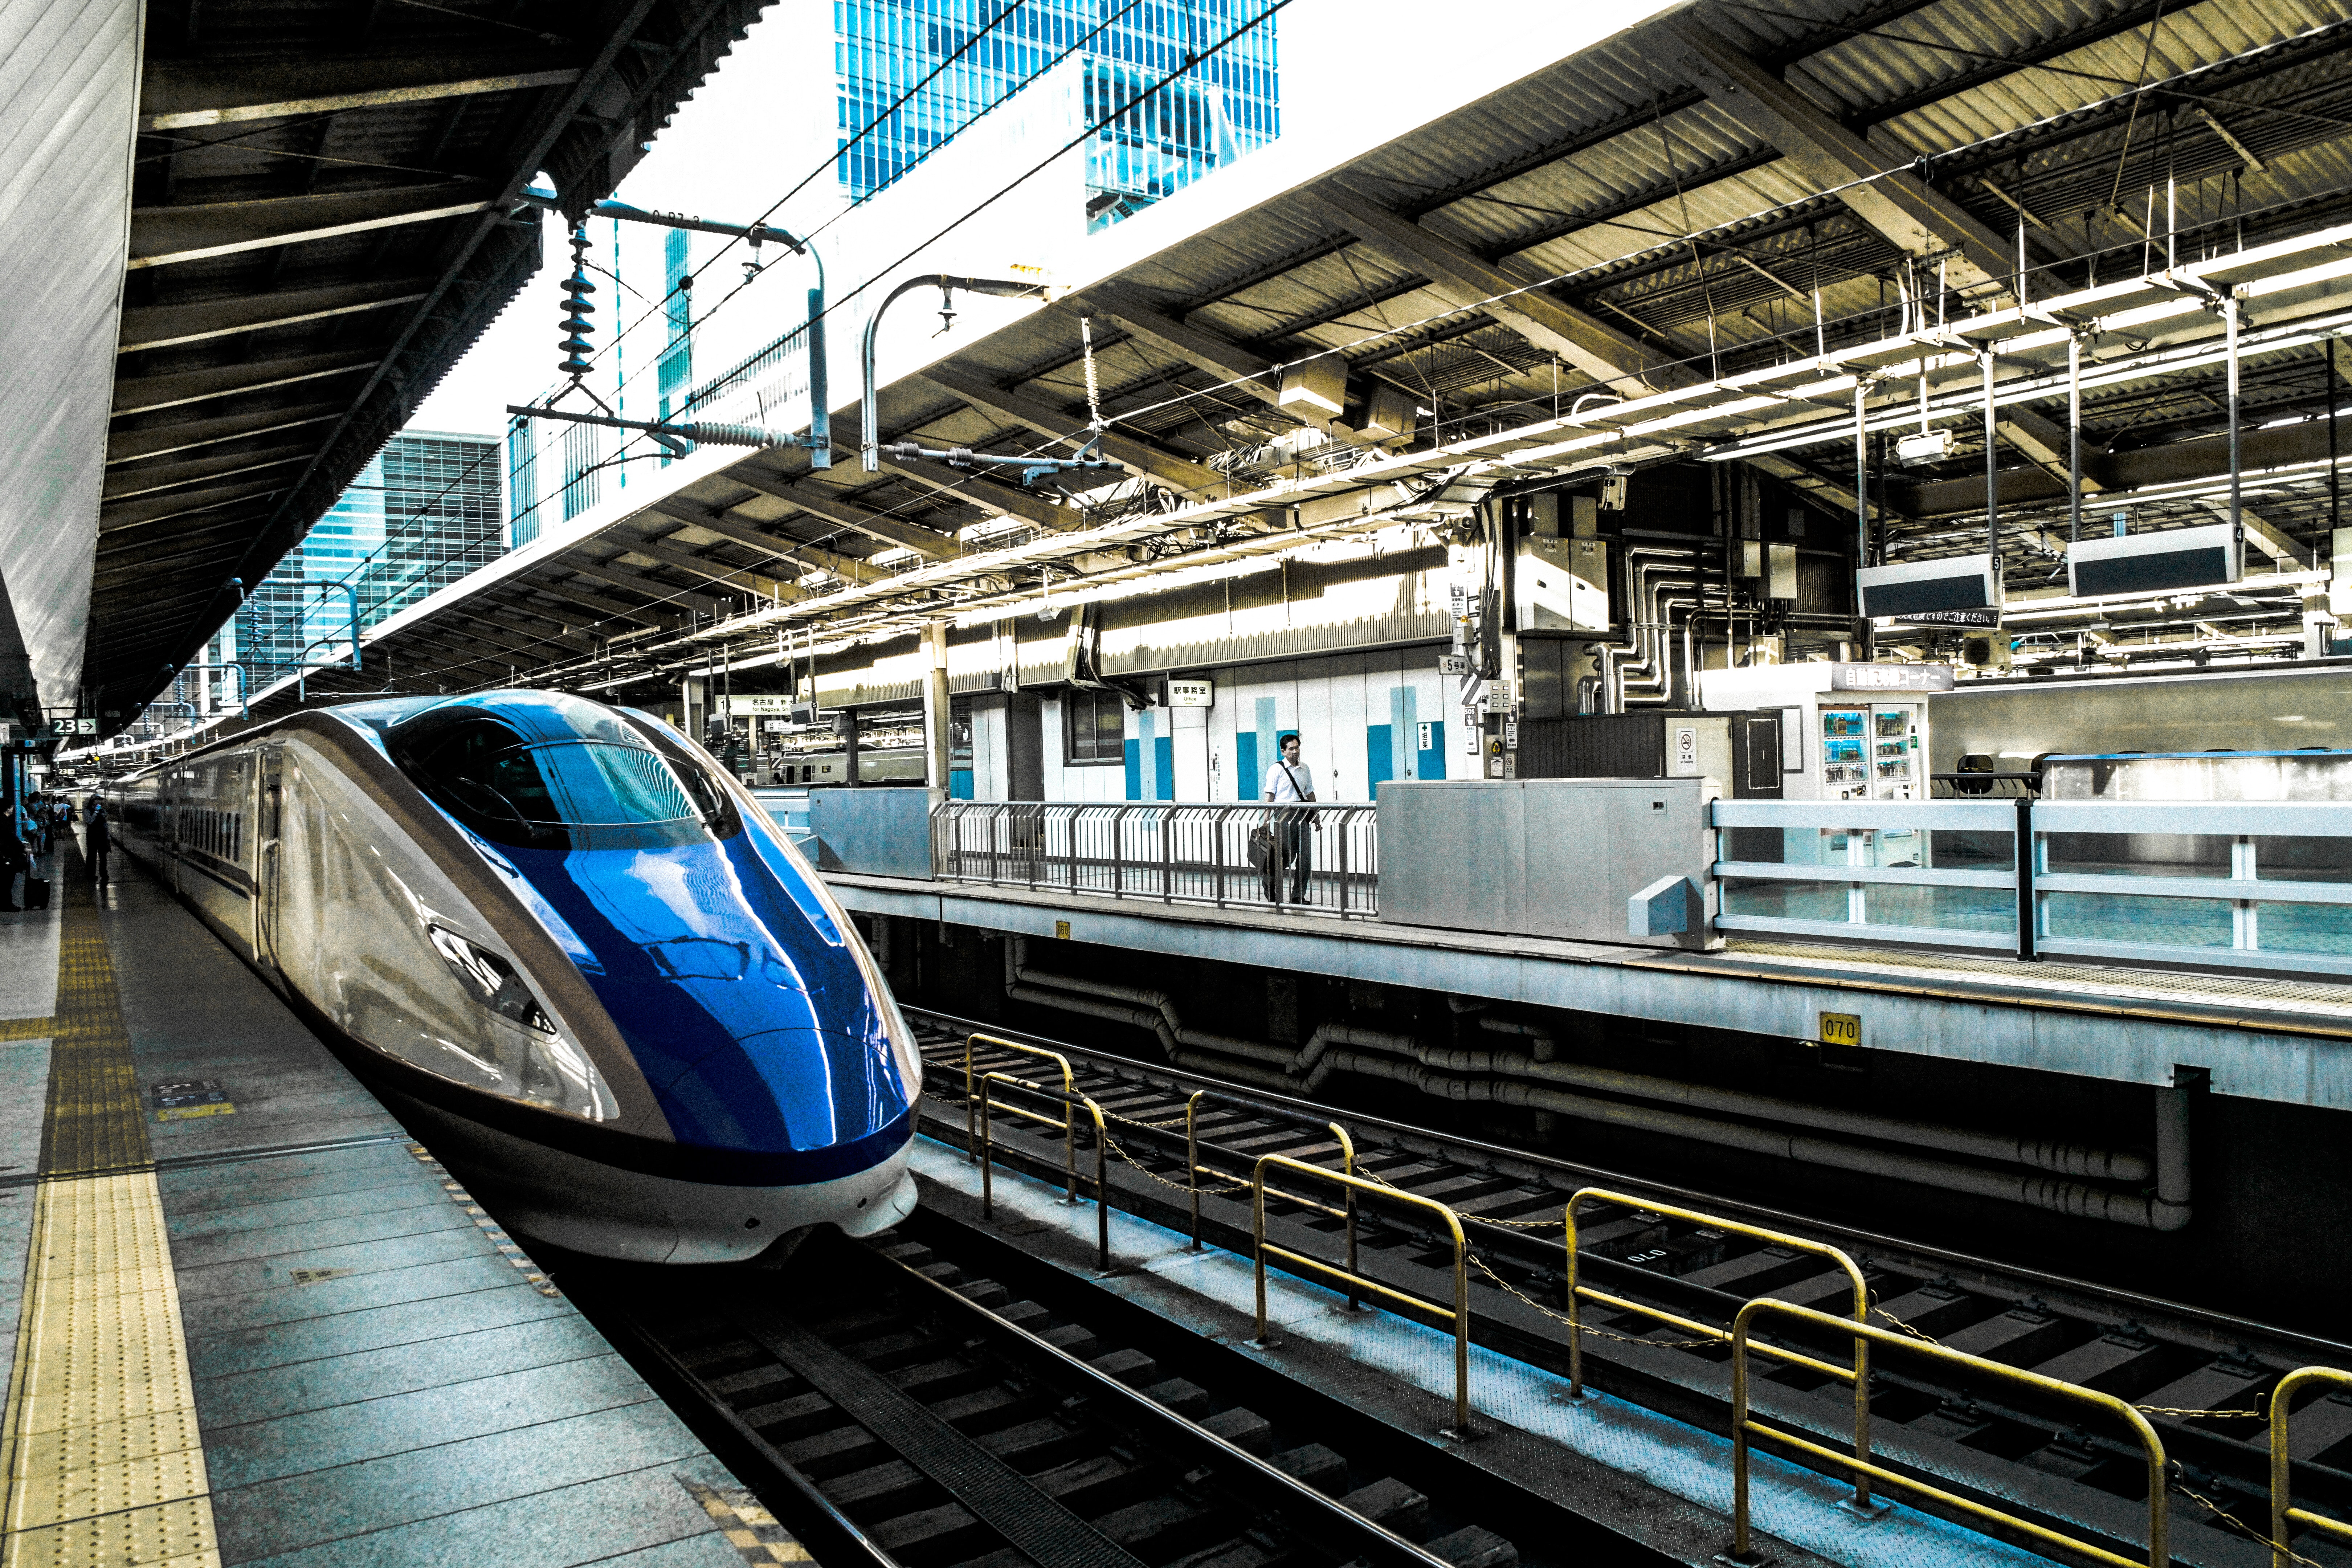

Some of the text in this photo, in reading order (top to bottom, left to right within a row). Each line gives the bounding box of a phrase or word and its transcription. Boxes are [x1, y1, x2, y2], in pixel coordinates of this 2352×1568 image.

[2237, 529, 2242, 541] 4
[1994, 558, 1999, 569] 5
[54, 719, 76, 732] 23
[1422, 732, 1428, 748] 担架
[1058, 925, 1068, 935] 060
[1826, 1020, 1854, 1038] 070
